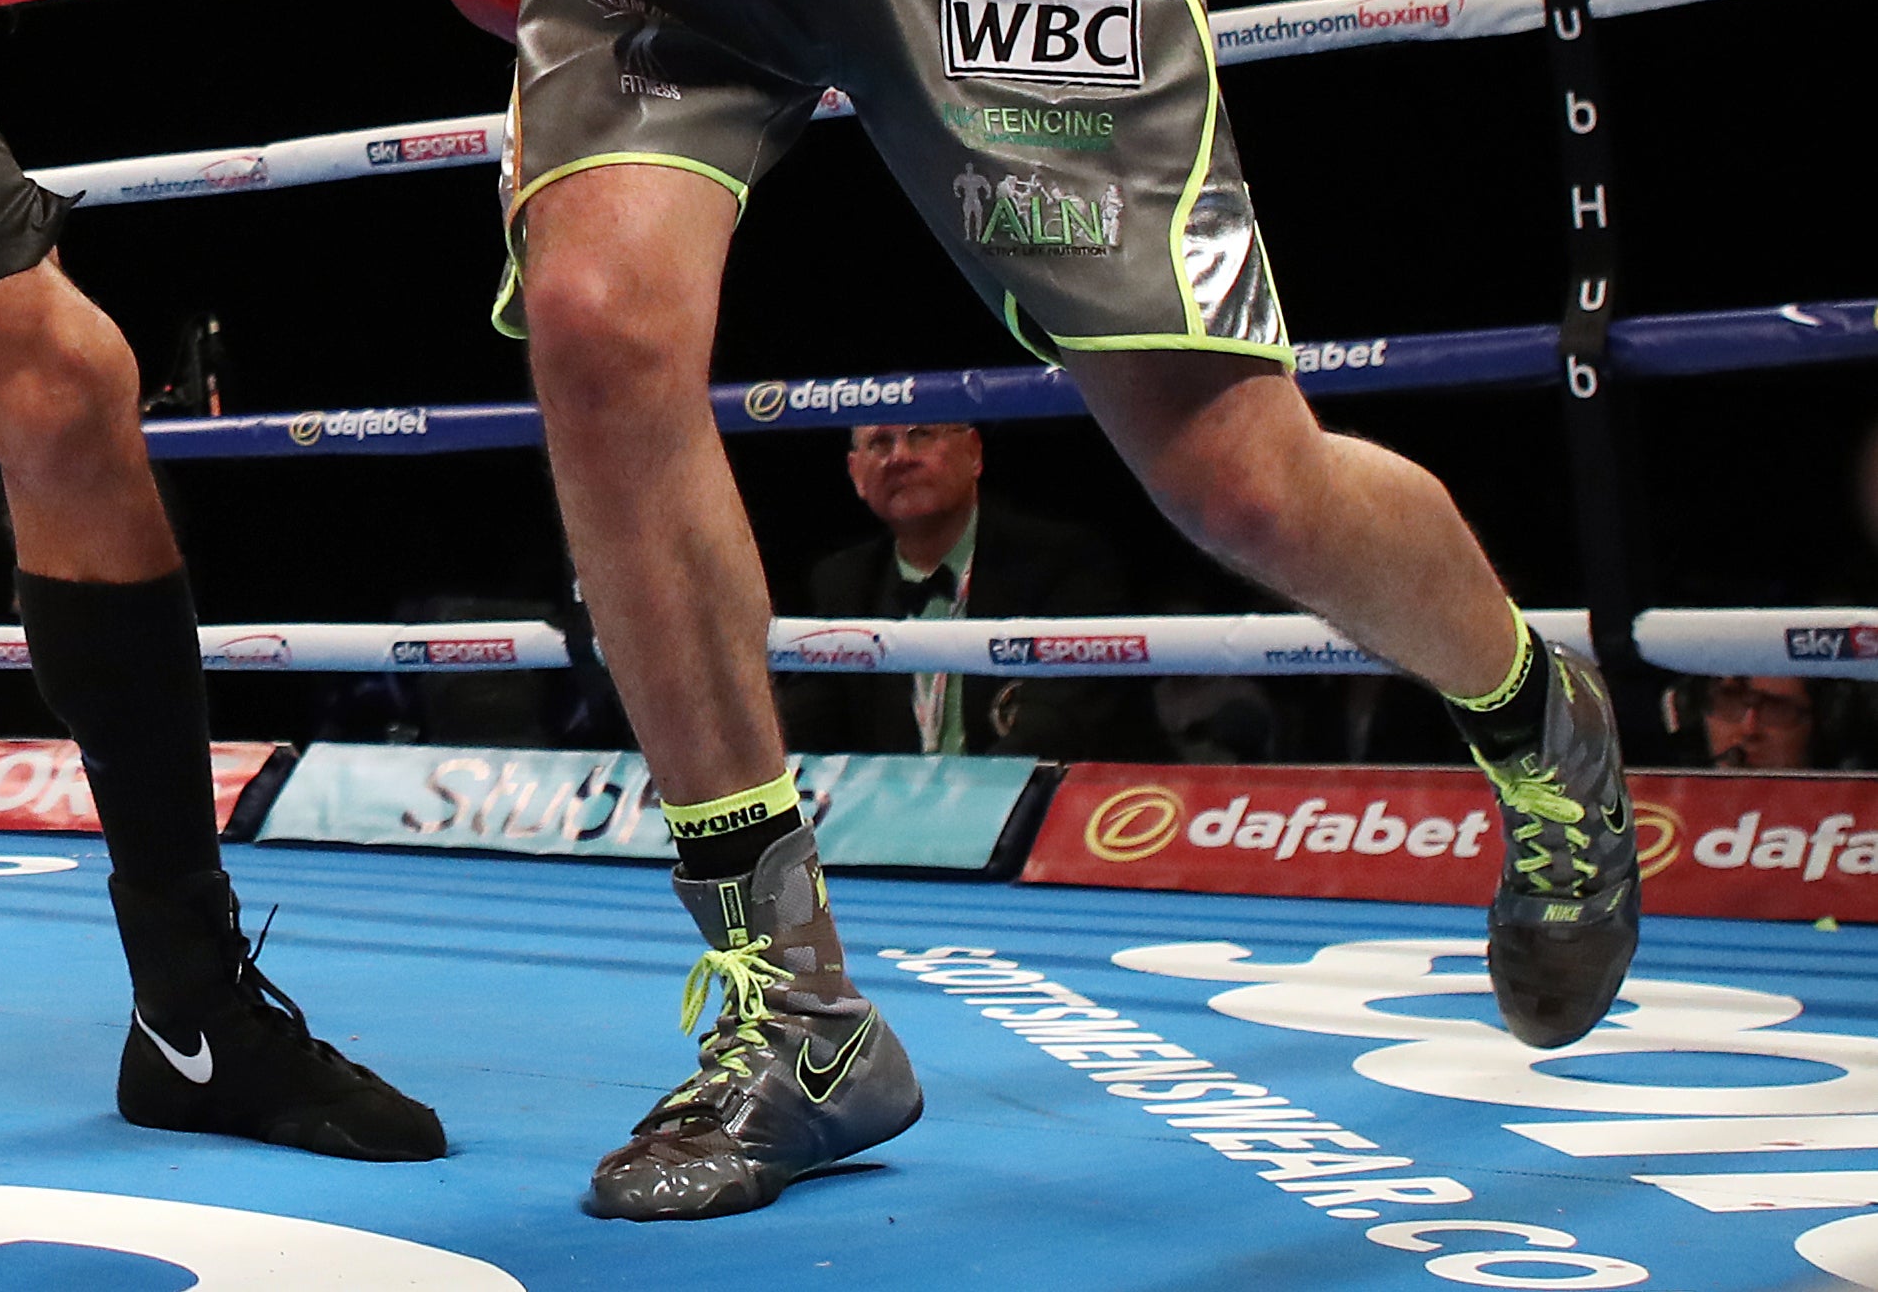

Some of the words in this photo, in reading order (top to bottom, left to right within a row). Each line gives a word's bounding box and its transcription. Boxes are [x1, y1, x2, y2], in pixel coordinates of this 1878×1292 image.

[951, 0, 1130, 66] WBC
[982, 107, 1115, 136] FENCING
[369, 140, 400, 165] sky
[402, 130, 486, 161] SPORTS
[980, 196, 1105, 246] ALN
[789, 377, 915, 414] dafabet
[324, 409, 427, 440] dafabet
[430, 640, 514, 663] SPORTS
[992, 639, 1032, 665] sky
[1035, 637, 1147, 663] SPORTS
[1789, 630, 1846, 660] sky
[676, 801, 770, 838] WONG
[1187, 795, 1491, 861] dafabet
[1542, 903, 1584, 922] NIKE
